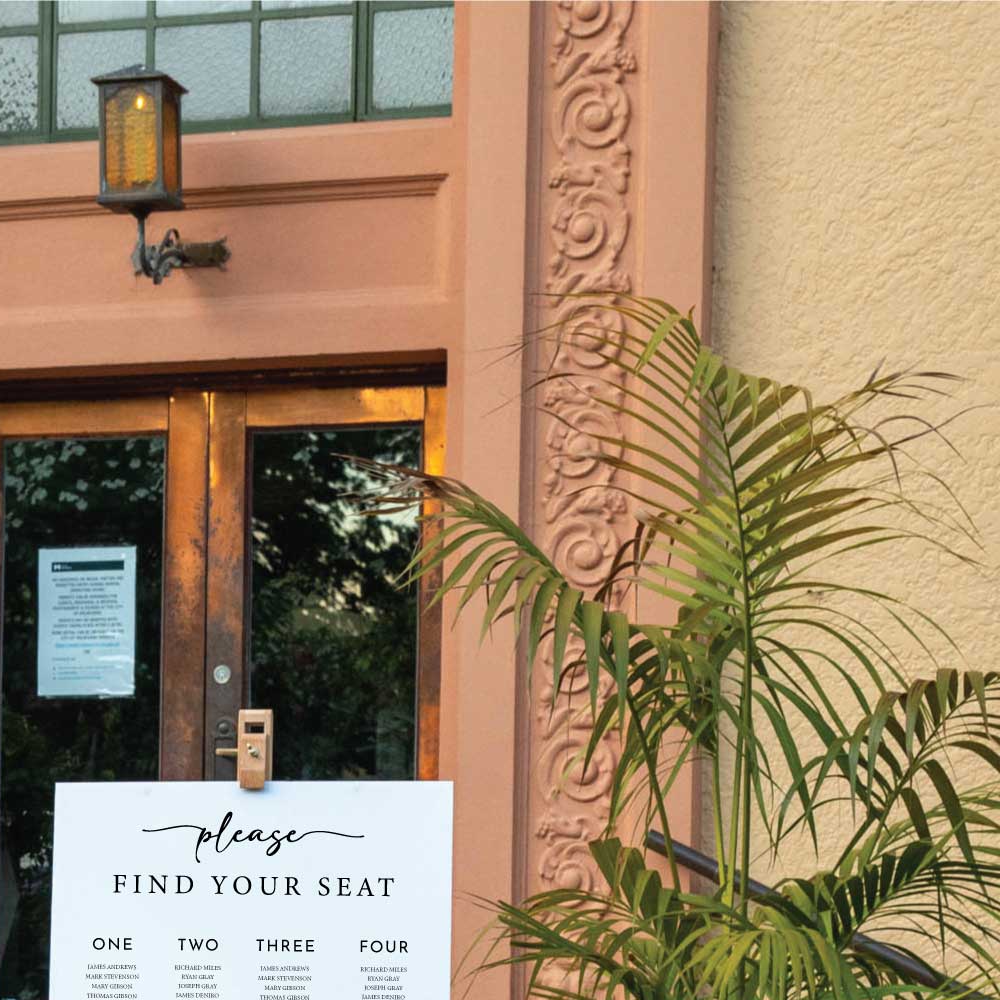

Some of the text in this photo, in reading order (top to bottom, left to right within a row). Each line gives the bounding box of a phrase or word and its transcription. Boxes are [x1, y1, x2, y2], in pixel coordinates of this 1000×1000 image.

[142, 812, 364, 863] please
[113, 875, 394, 896] FIND YOUR SEAT
[93, 938, 132, 950] ONE
[178, 939, 218, 951] TWO
[256, 939, 314, 952] THREE
[361, 940, 408, 953] FOUR
